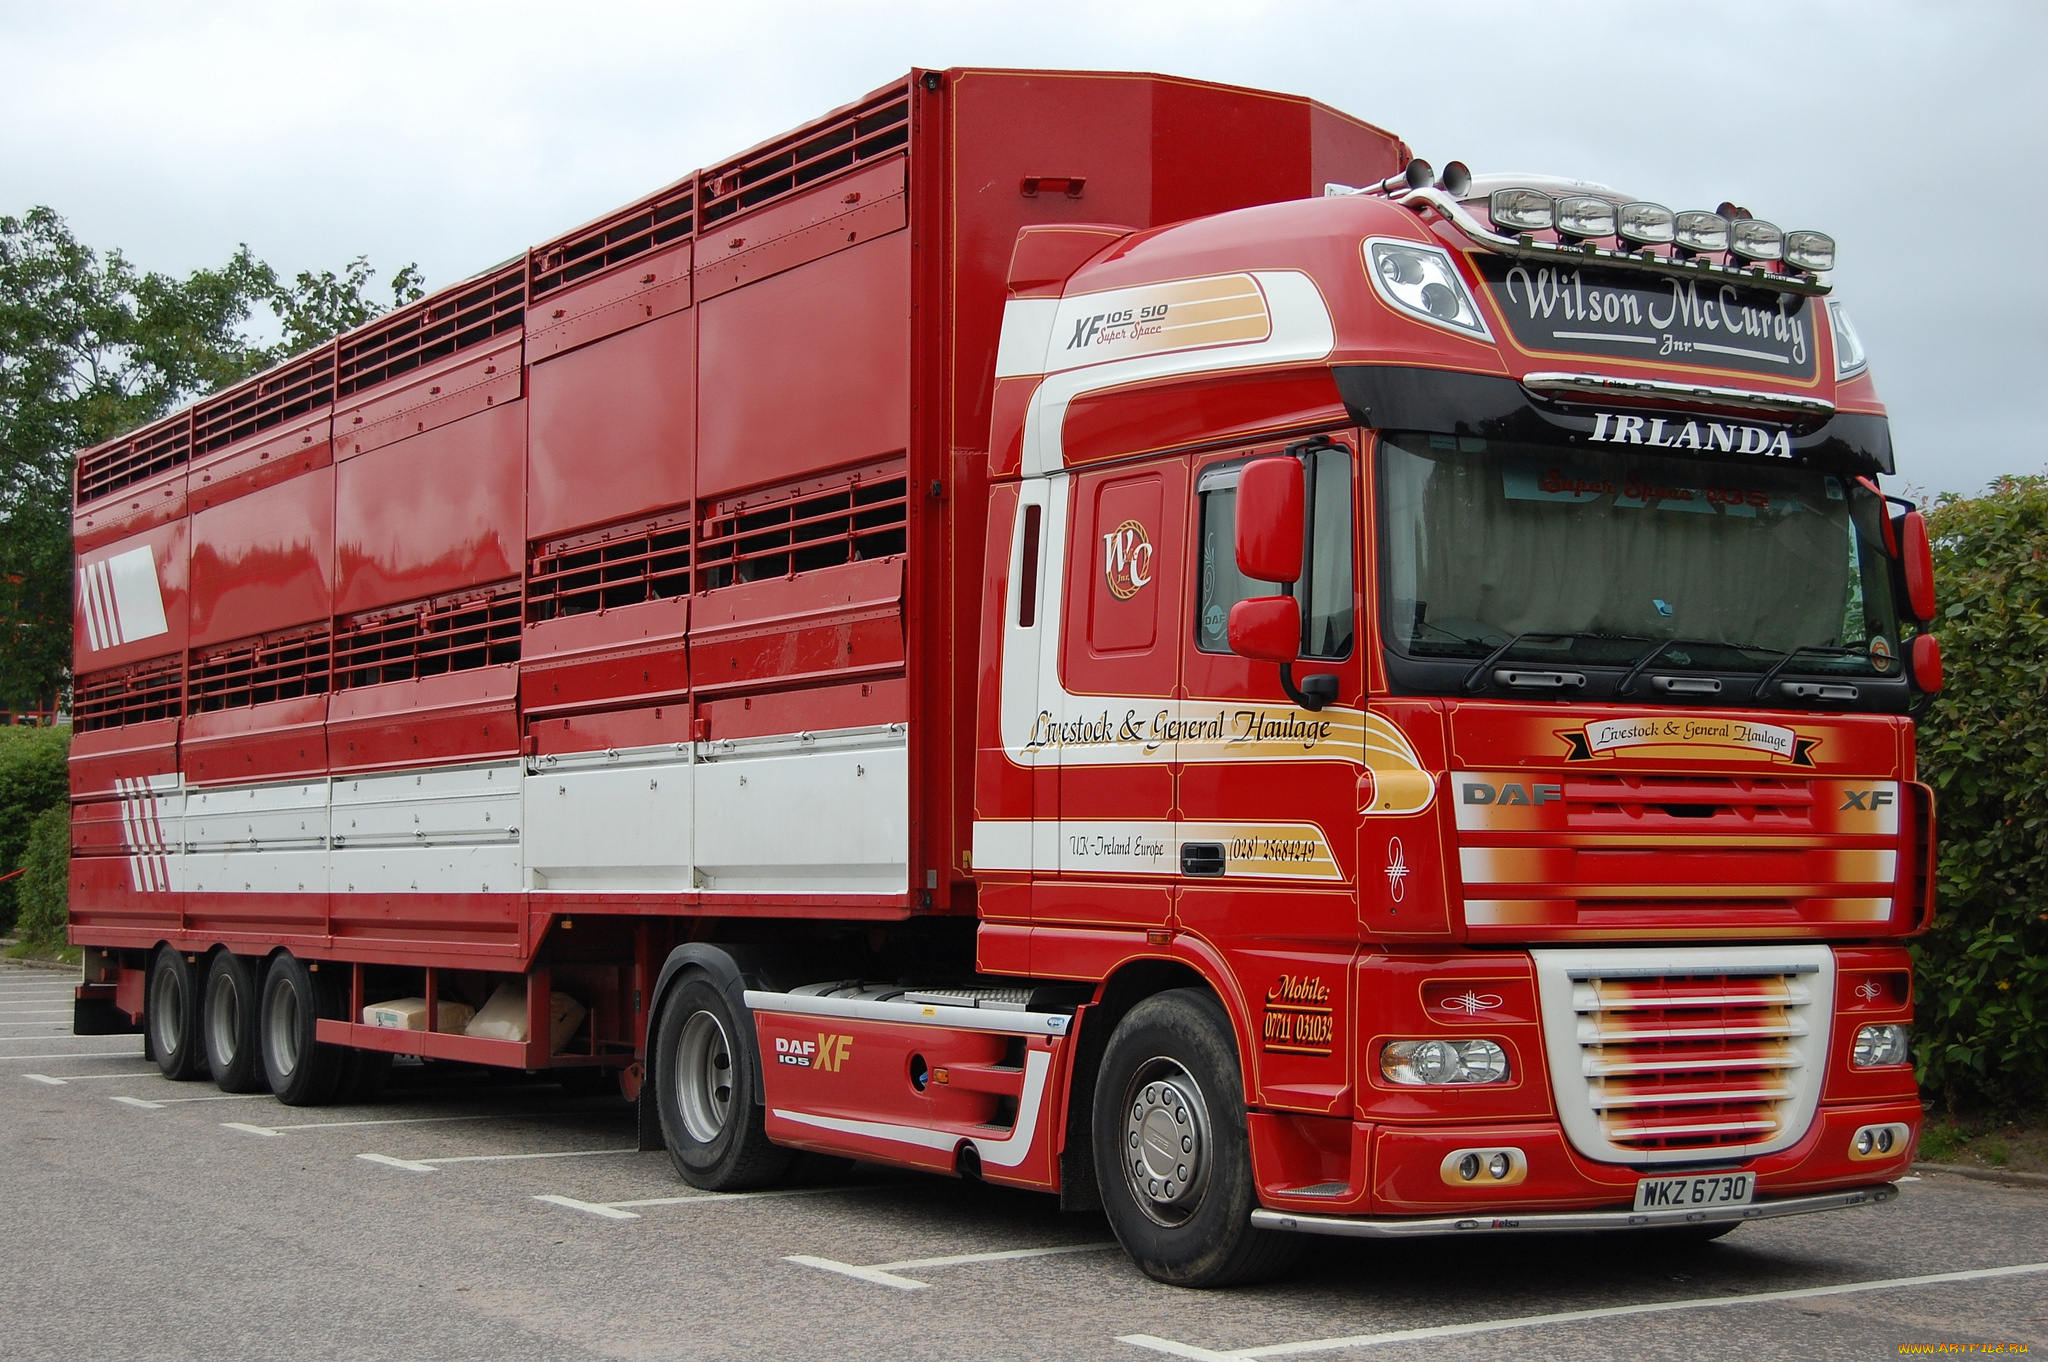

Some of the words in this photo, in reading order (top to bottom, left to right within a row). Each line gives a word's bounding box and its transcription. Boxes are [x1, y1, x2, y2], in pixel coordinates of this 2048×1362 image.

[1505, 266, 1642, 325] Wilson
[1066, 314, 1105, 350] XF
[1106, 309, 1133, 324] 105
[1140, 304, 1168, 318] 510
[1096, 326, 1126, 345] Super
[1130, 321, 1162, 340] Space
[1588, 412, 1794, 459] IRLANDA
[1543, 468, 1615, 498] Super
[1623, 474, 1694, 502] Space
[1706, 485, 1770, 508] 105
[1204, 613, 1226, 625] DAF
[1024, 709, 1114, 748] Livestock
[1119, 709, 1146, 741] &
[1146, 709, 1225, 750] General
[1227, 710, 1332, 749] Haulage
[1596, 722, 1659, 746] Livestock
[1663, 721, 1681, 735] &
[1683, 721, 1729, 740] General
[1732, 725, 1786, 751] Haulage
[1462, 782, 1562, 806] DAF
[1838, 789, 1894, 812] XF
[1133, 835, 1164, 864] Europe
[1229, 835, 1258, 862] (028)
[1263, 837, 1315, 863] 25684249
[1267, 974, 1331, 1001] Mobile:
[1264, 1012, 1291, 1039] 07711
[1296, 1014, 1333, 1042] 031032
[775, 1037, 815, 1055] DAF
[779, 1054, 810, 1067] 105
[813, 1032, 854, 1073] XF
[1643, 1180, 1687, 1206] WKZ
[1691, 1176, 1747, 1203] 6730
